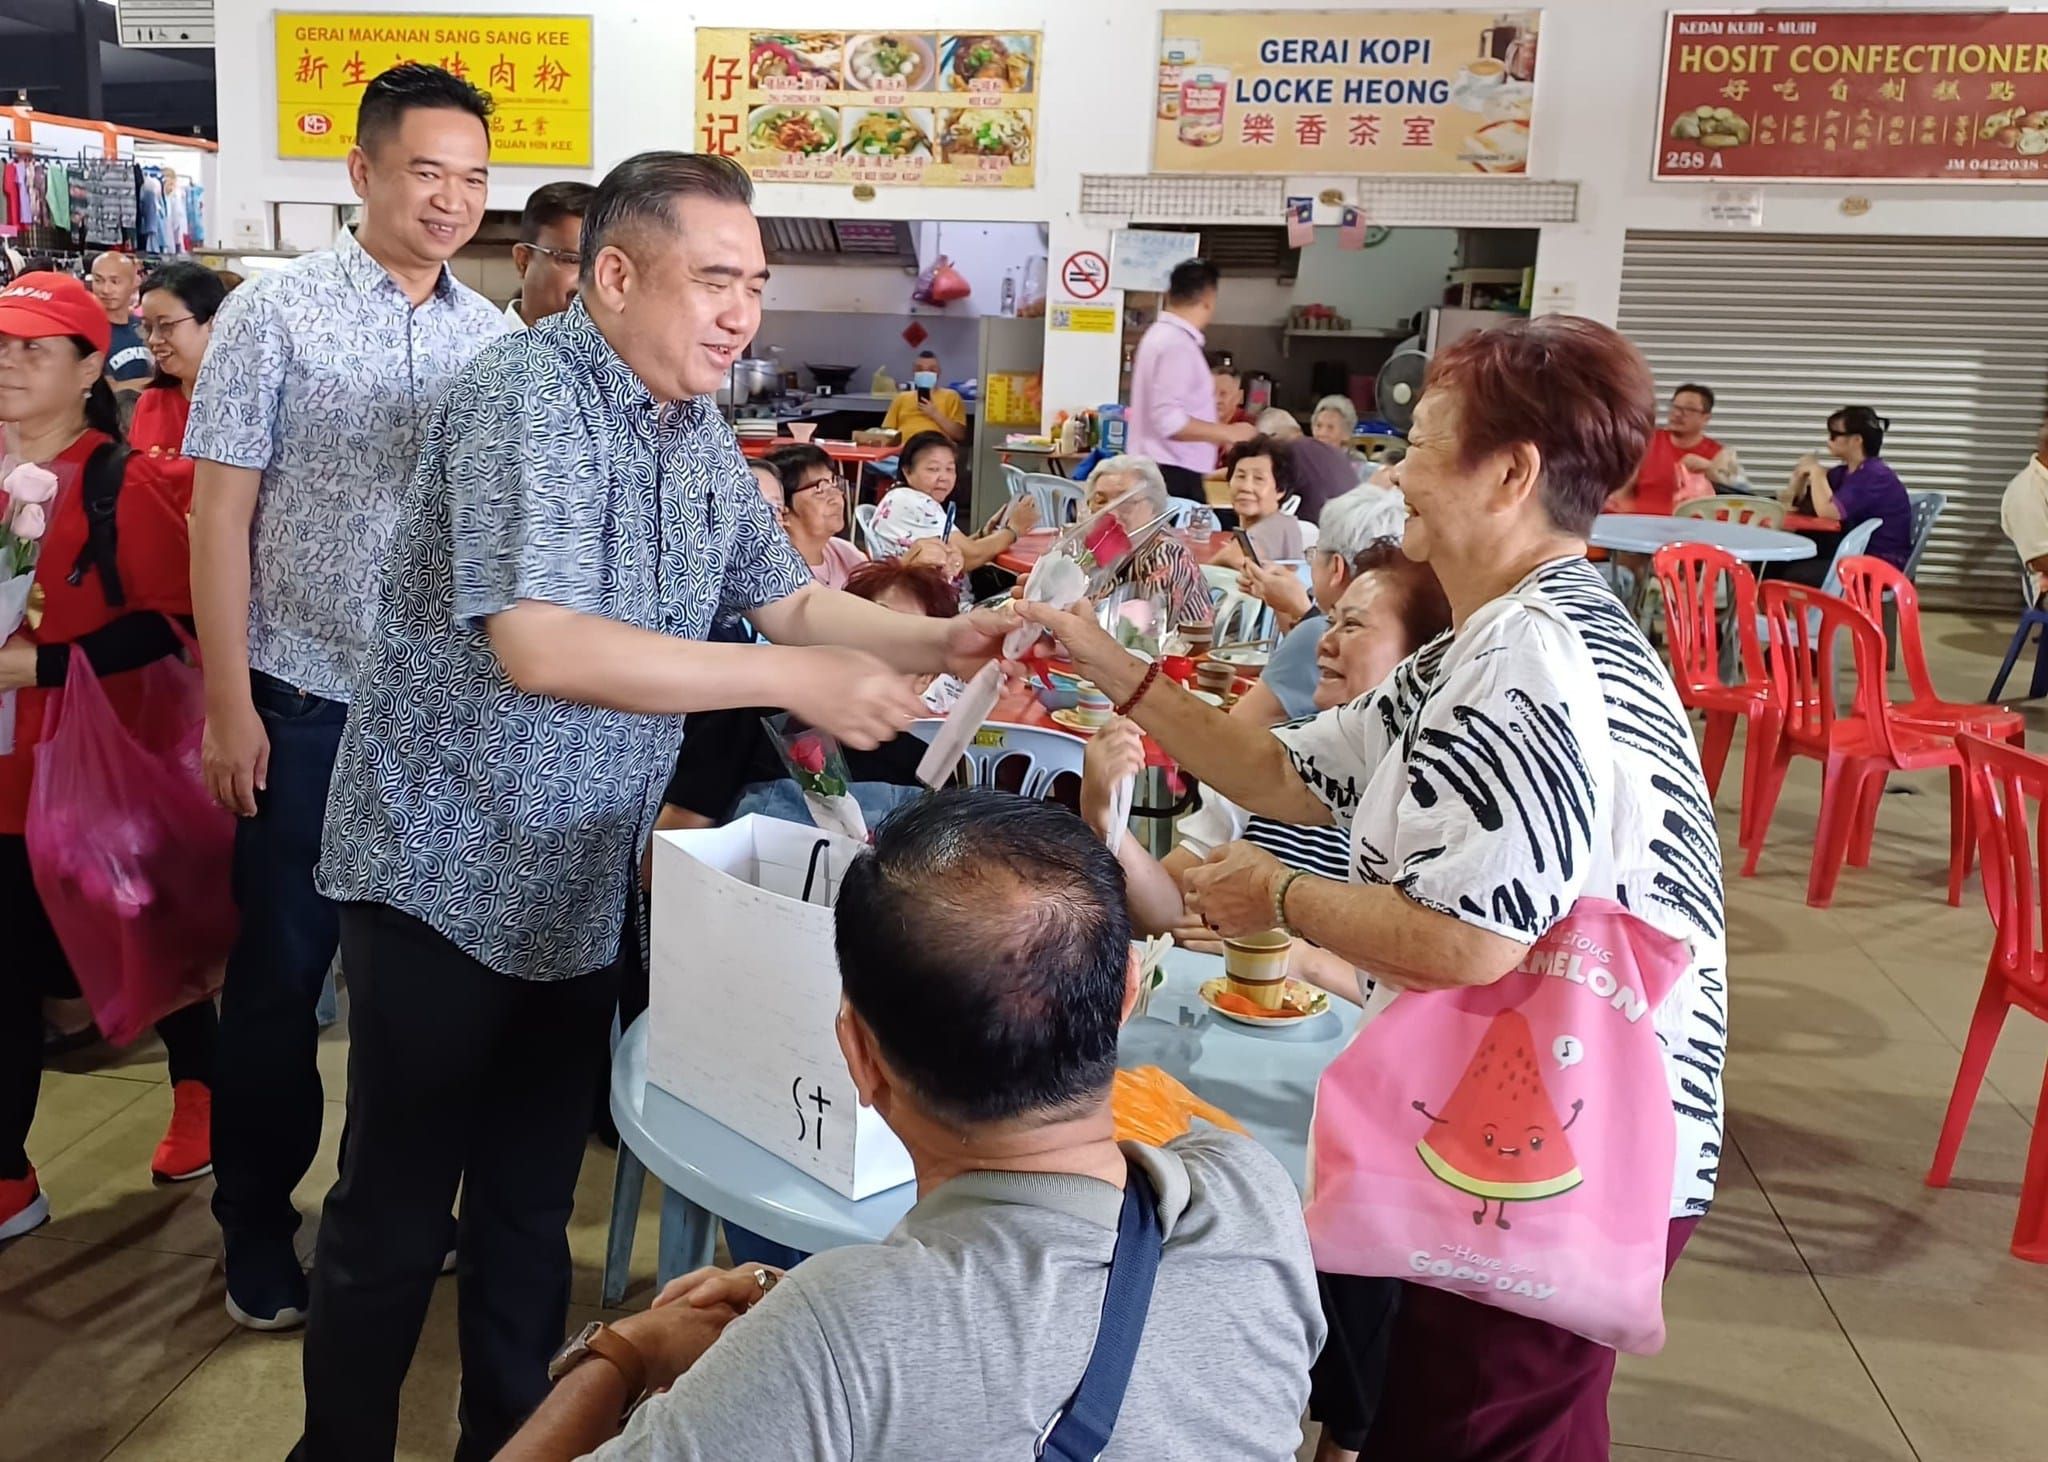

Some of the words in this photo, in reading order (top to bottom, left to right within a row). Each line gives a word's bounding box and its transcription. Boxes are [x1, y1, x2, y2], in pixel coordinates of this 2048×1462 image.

[295, 27, 344, 41] GERAI
[349, 28, 430, 43] MAKANAN
[435, 30, 481, 44] SANG
[486, 31, 532, 45] SANG
[537, 31, 570, 46] KEE
[1679, 21, 1723, 35] KEDAI
[1260, 39, 1348, 64] GERAI
[1360, 39, 1430, 64] KOPI
[1679, 44, 1780, 73] HOSIT
[1789, 44, 2048, 74] CONFECTIONER
[1236, 78, 1333, 103] LOCKE
[1343, 79, 1449, 104] HEONG
[1241, 113, 1435, 146] 樂香茶室
[1666, 151, 1705, 169] 258
[1710, 151, 1723, 169] A
[1945, 159, 1965, 171] JM
[1516, 950, 1648, 1024] MELON
[1409, 1250, 1490, 1284] GOOD
[1495, 1276, 1557, 1300] DAY
